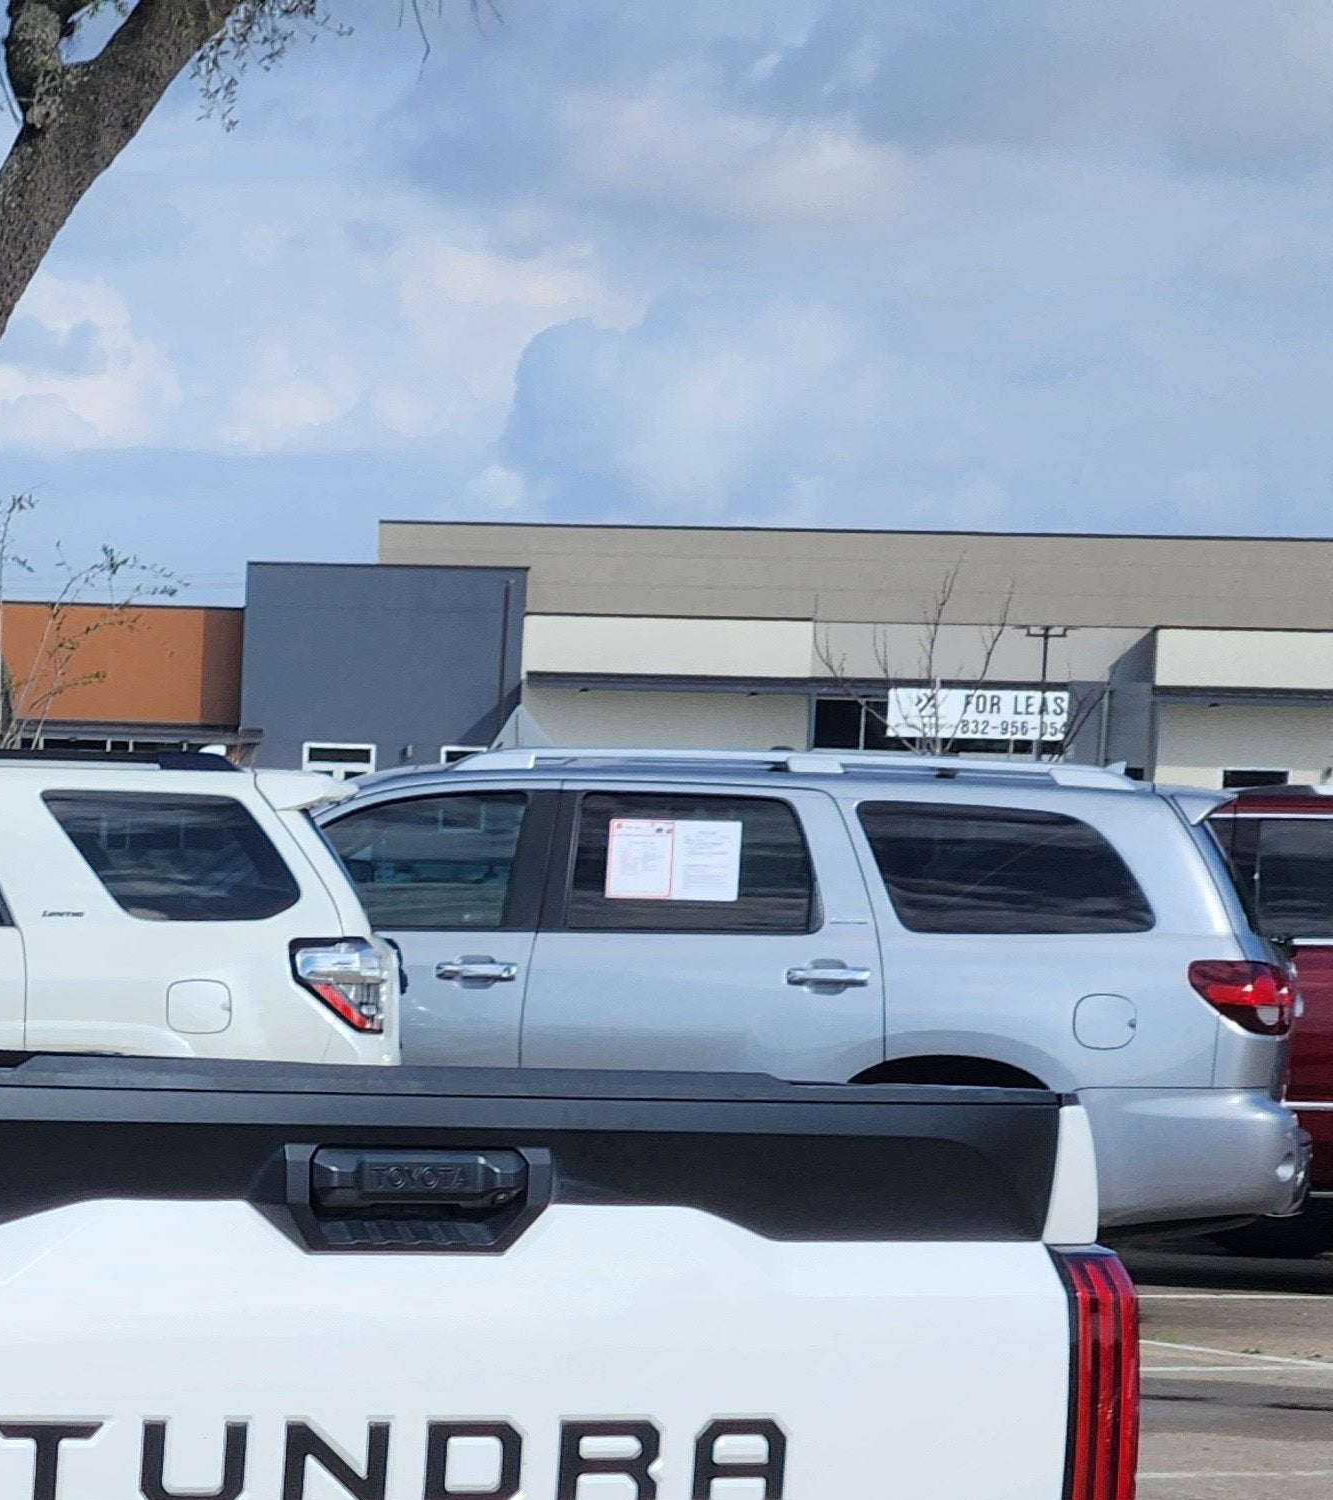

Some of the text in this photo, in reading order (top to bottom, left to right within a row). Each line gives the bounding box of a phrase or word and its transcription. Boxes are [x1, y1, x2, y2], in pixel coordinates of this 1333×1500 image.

[963, 694, 1065, 716] FOR LEAS
[371, 1165, 467, 1190] TOYOTA
